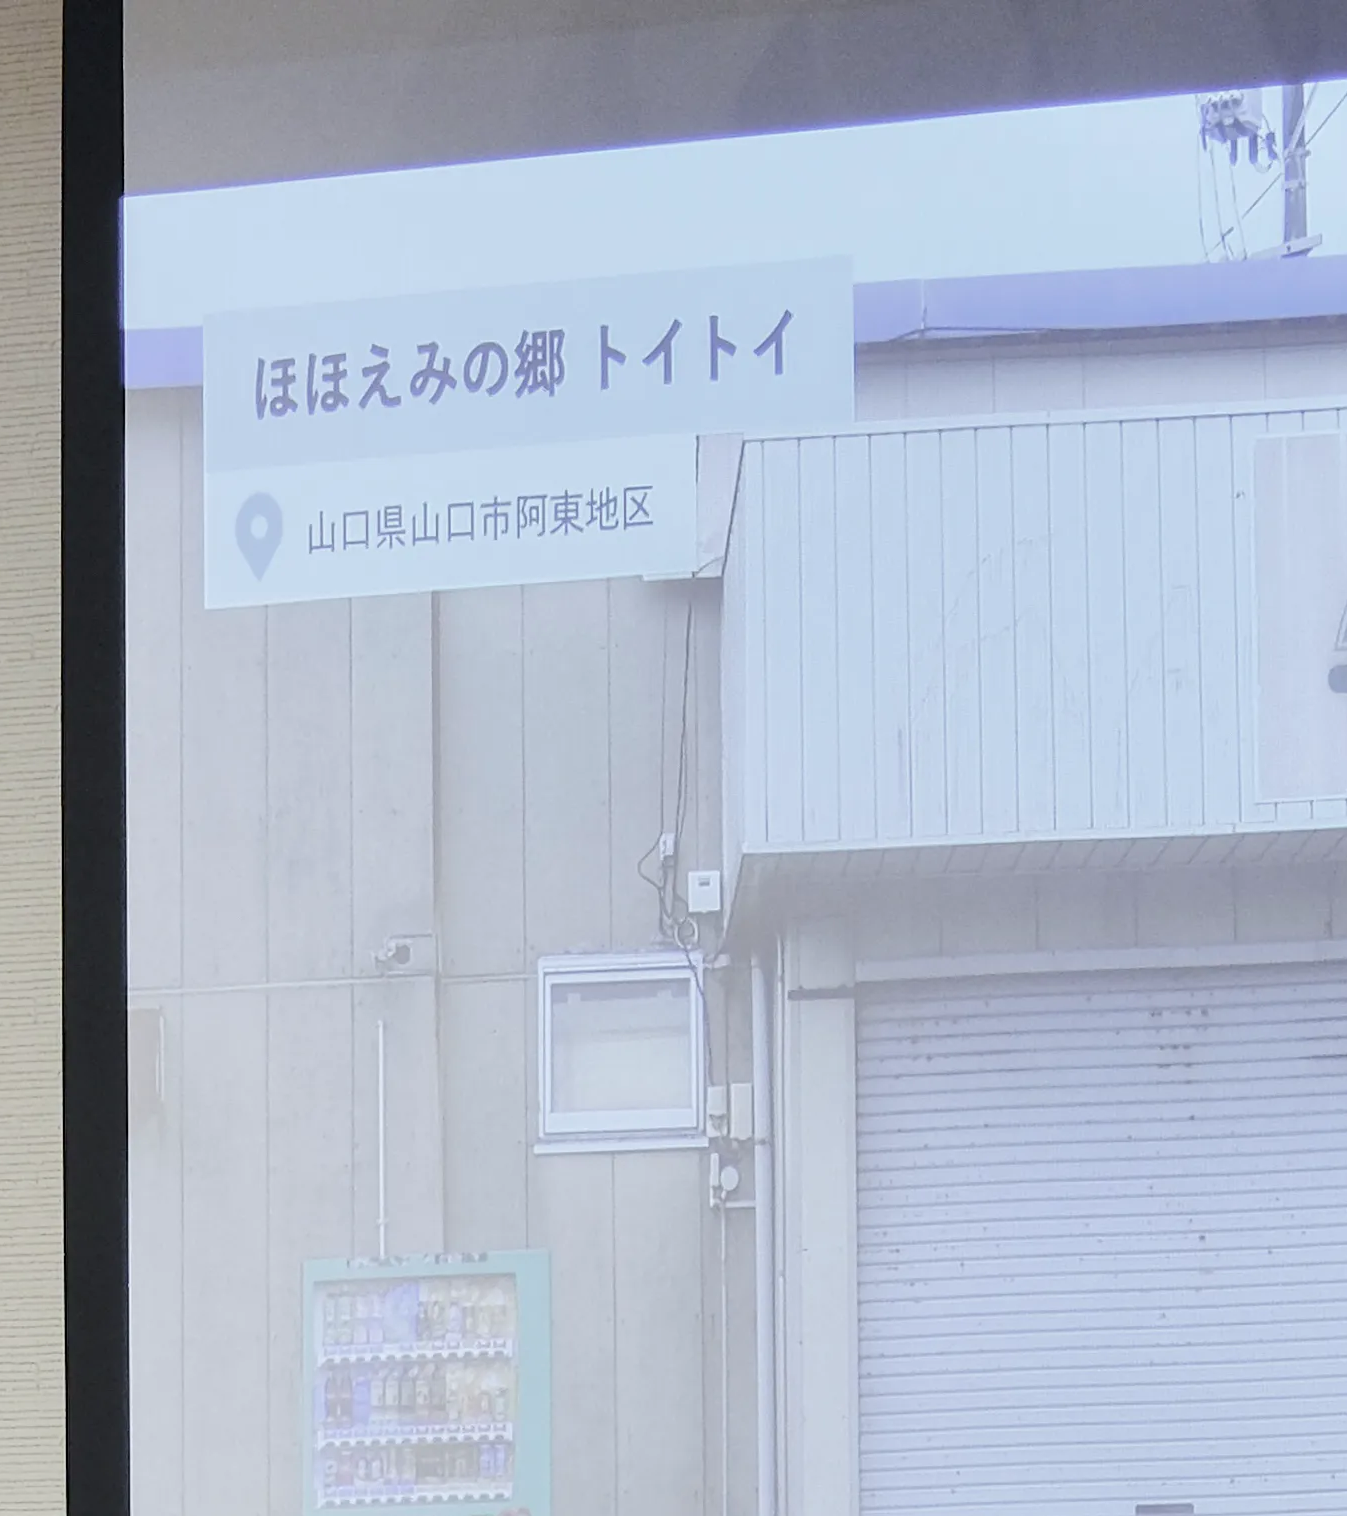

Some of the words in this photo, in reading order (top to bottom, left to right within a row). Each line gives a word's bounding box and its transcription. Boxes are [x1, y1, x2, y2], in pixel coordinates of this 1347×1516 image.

[255, 328, 565, 420] ほほえみの郷
[599, 309, 795, 391] トイトイ
[308, 485, 654, 555] 山口県山口市阿東地区
